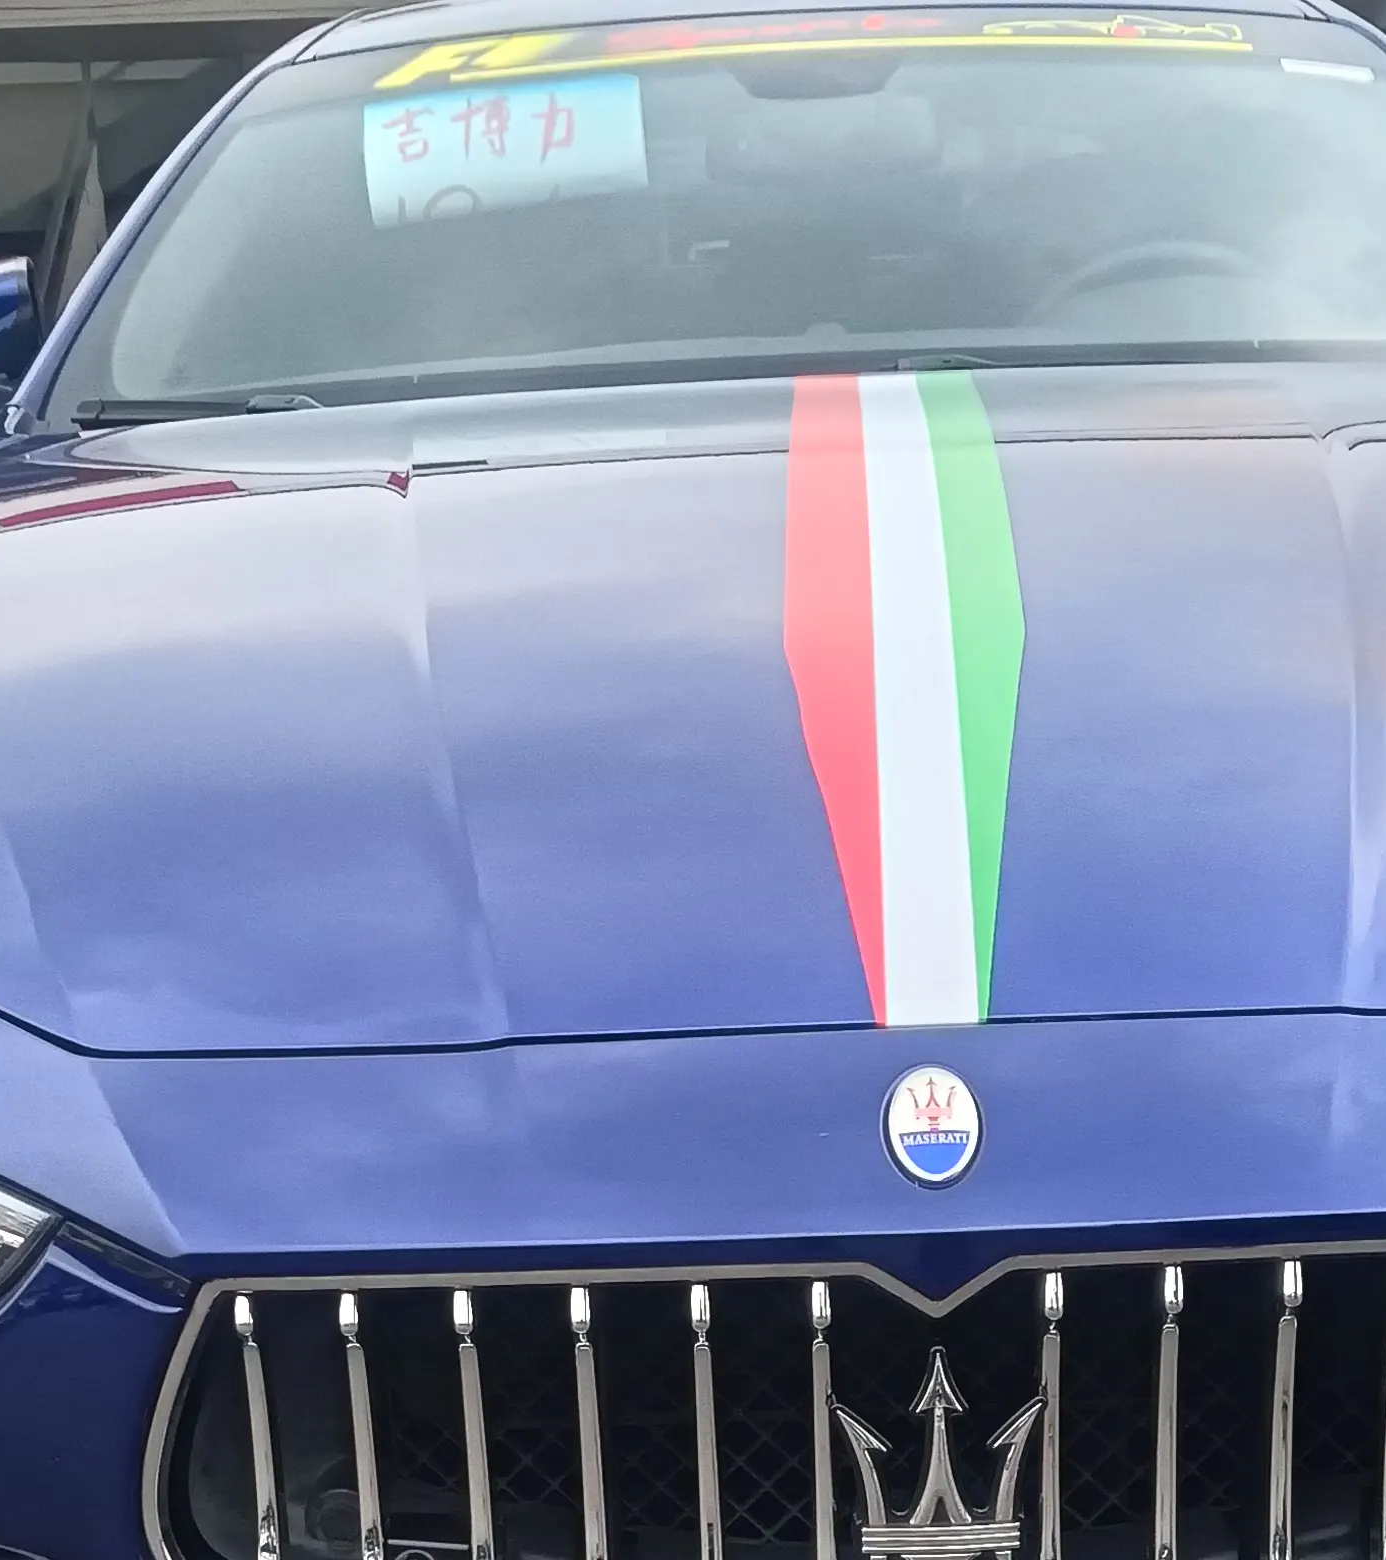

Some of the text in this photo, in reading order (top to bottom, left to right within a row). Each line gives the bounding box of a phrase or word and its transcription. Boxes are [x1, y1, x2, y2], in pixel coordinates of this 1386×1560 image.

[381, 91, 575, 165] 吉博力
[903, 1133, 968, 1146] MASERATI
